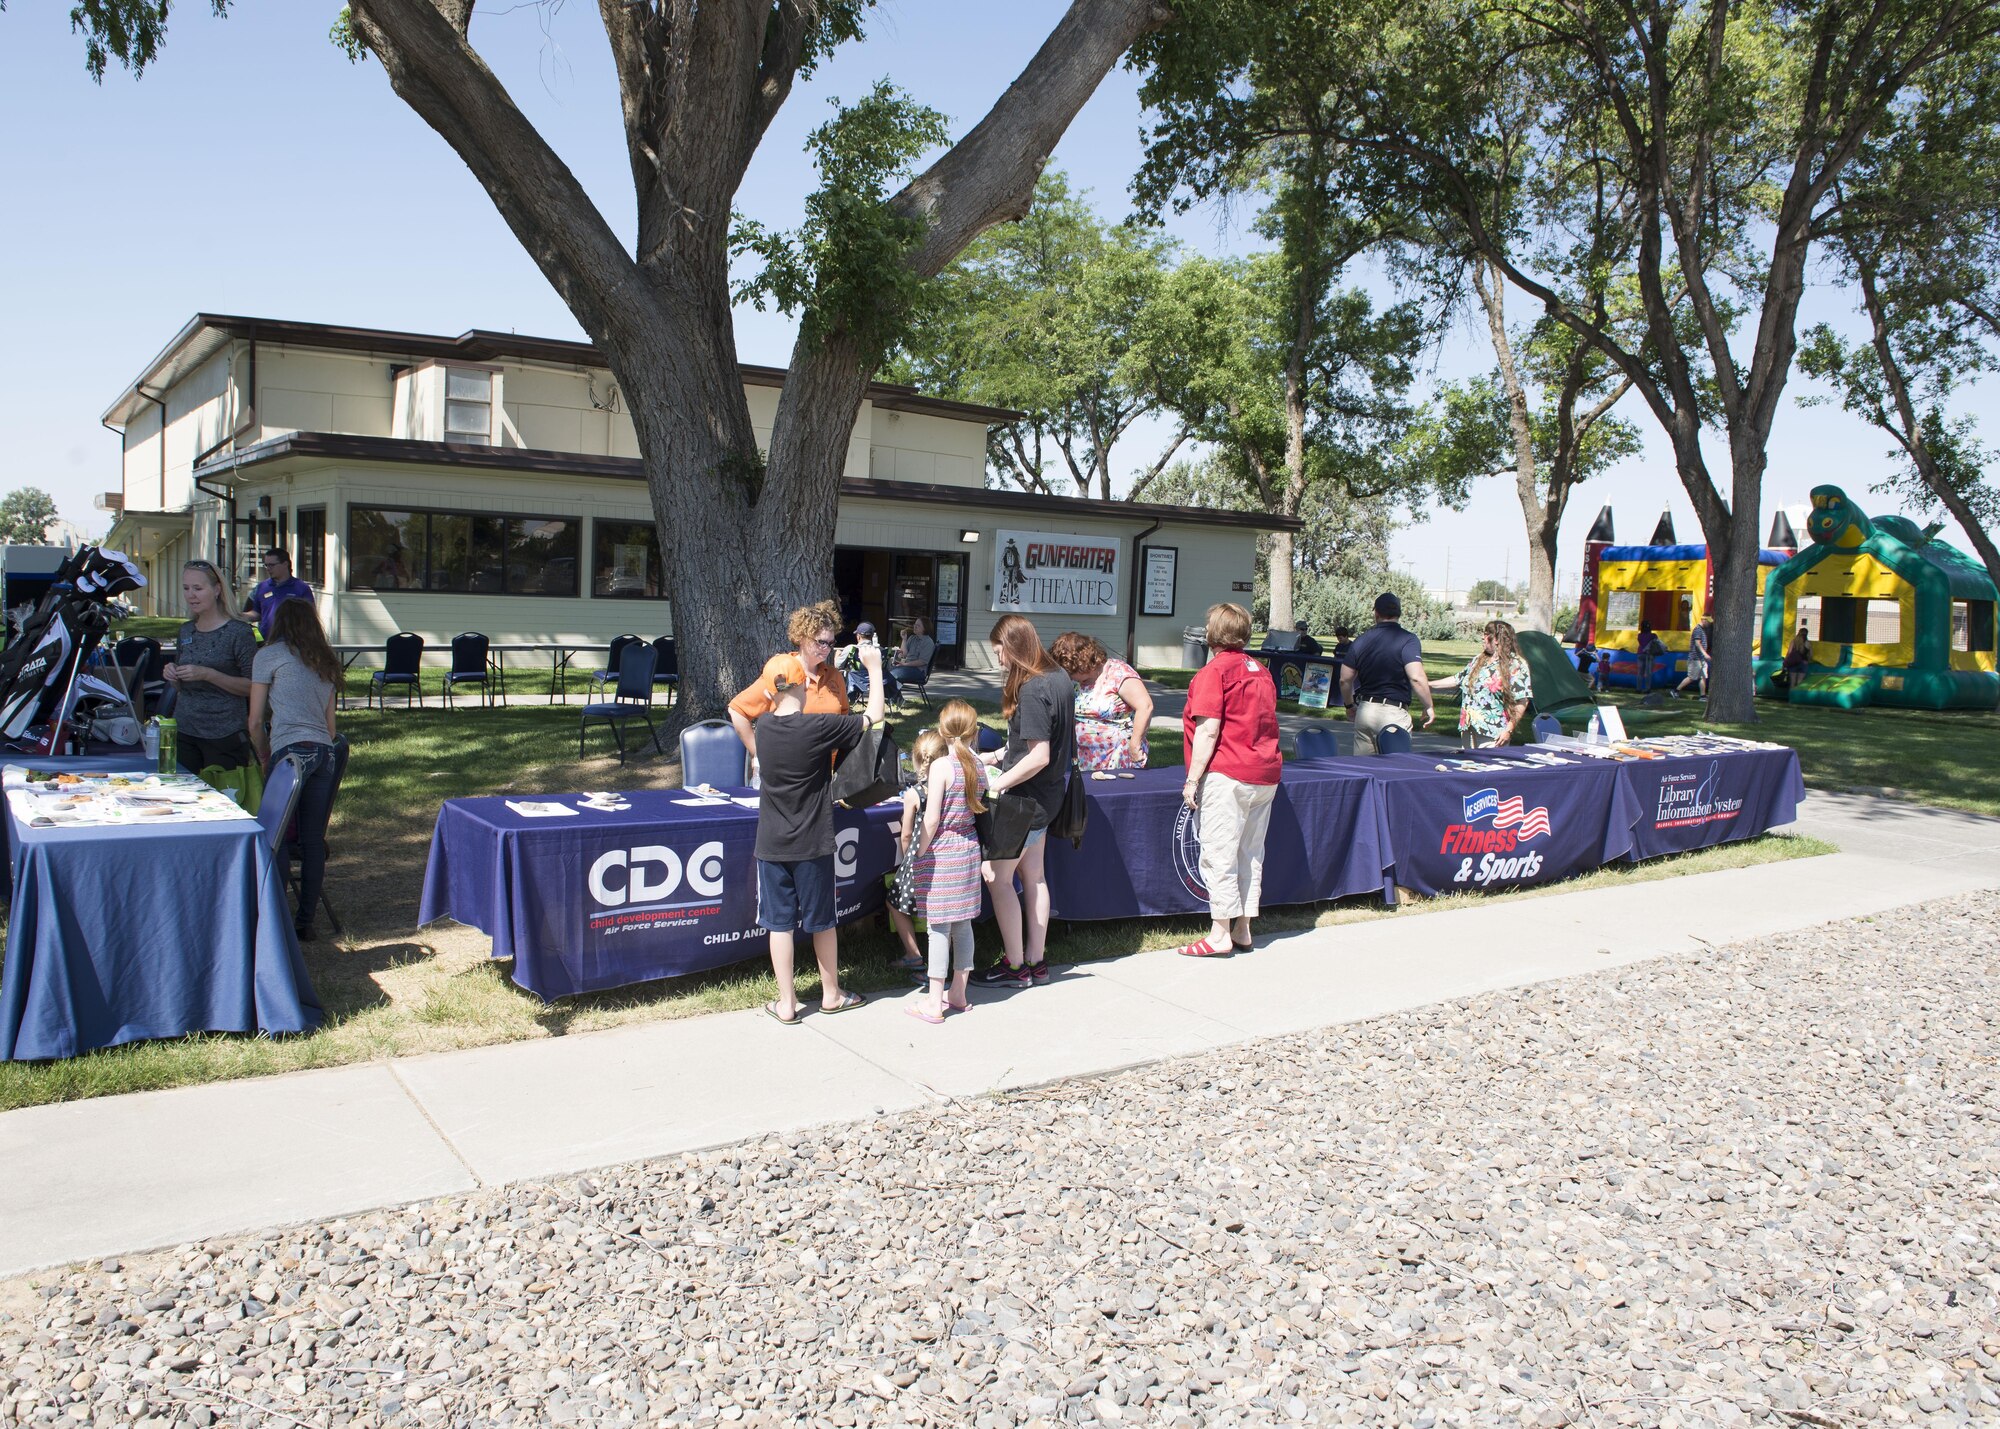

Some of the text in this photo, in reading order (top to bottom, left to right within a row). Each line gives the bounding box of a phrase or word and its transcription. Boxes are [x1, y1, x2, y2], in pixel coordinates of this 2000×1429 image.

[1025, 543, 1116, 574] GUNFIGHTER
[1028, 577, 1114, 606] THEATER
[1466, 795, 1498, 818] AF SERVICES
[1656, 796, 1742, 820] Information System
[1658, 784, 1696, 804] Library
[1440, 824, 1518, 854] Fitness
[588, 841, 723, 906] CDC
[1454, 850, 1543, 886] & Sports
[590, 906, 720, 929] child development center
[604, 918, 699, 935] Air Force Services
[703, 902, 861, 945] CHILD AND RAMS
